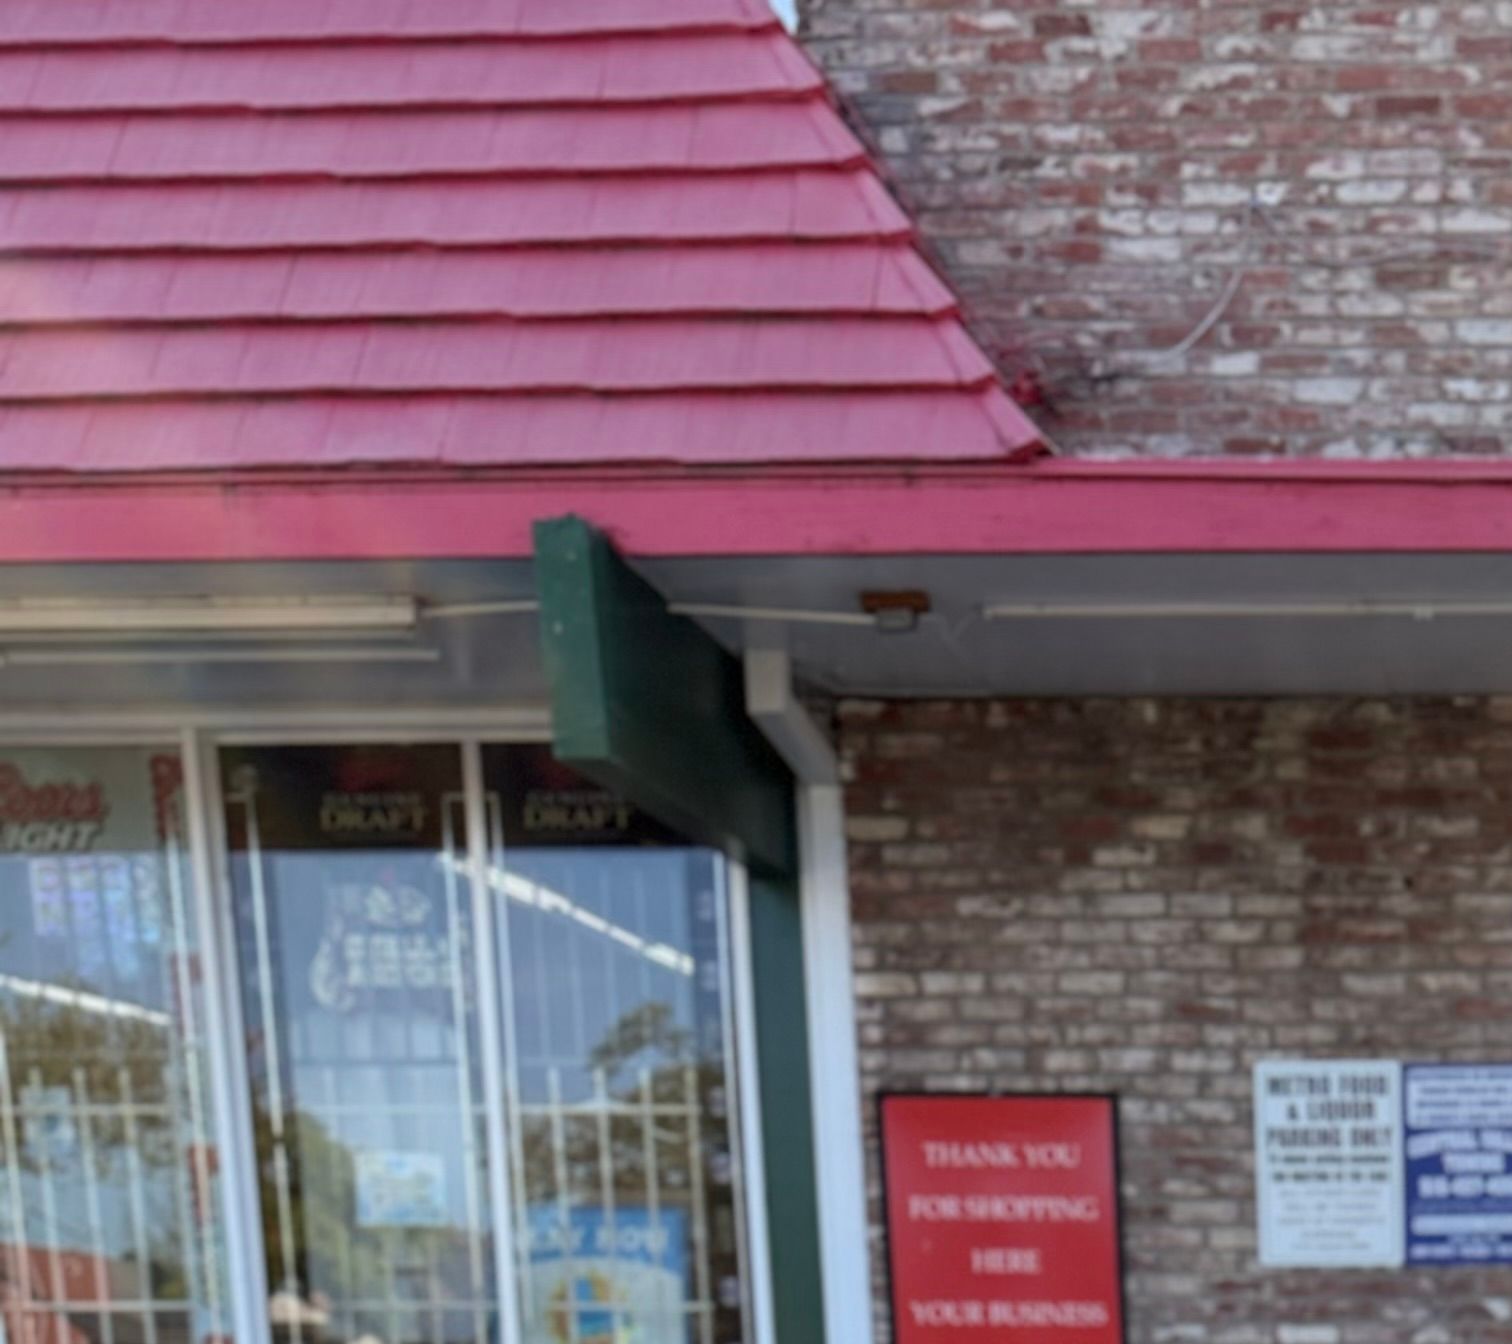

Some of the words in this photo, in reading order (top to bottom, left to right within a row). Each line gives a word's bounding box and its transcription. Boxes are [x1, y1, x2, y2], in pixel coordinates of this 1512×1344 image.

[0, 822, 100, 851] IGHT
[923, 1141, 1020, 1168] THANK
[1023, 1142, 1081, 1168] YOU
[909, 1194, 961, 1222] FOR
[964, 1195, 1099, 1222] SHOPPING
[970, 1249, 1041, 1274] HERE
[909, 1301, 987, 1327] YOUR
[988, 1302, 1108, 1327] BUSINESS
